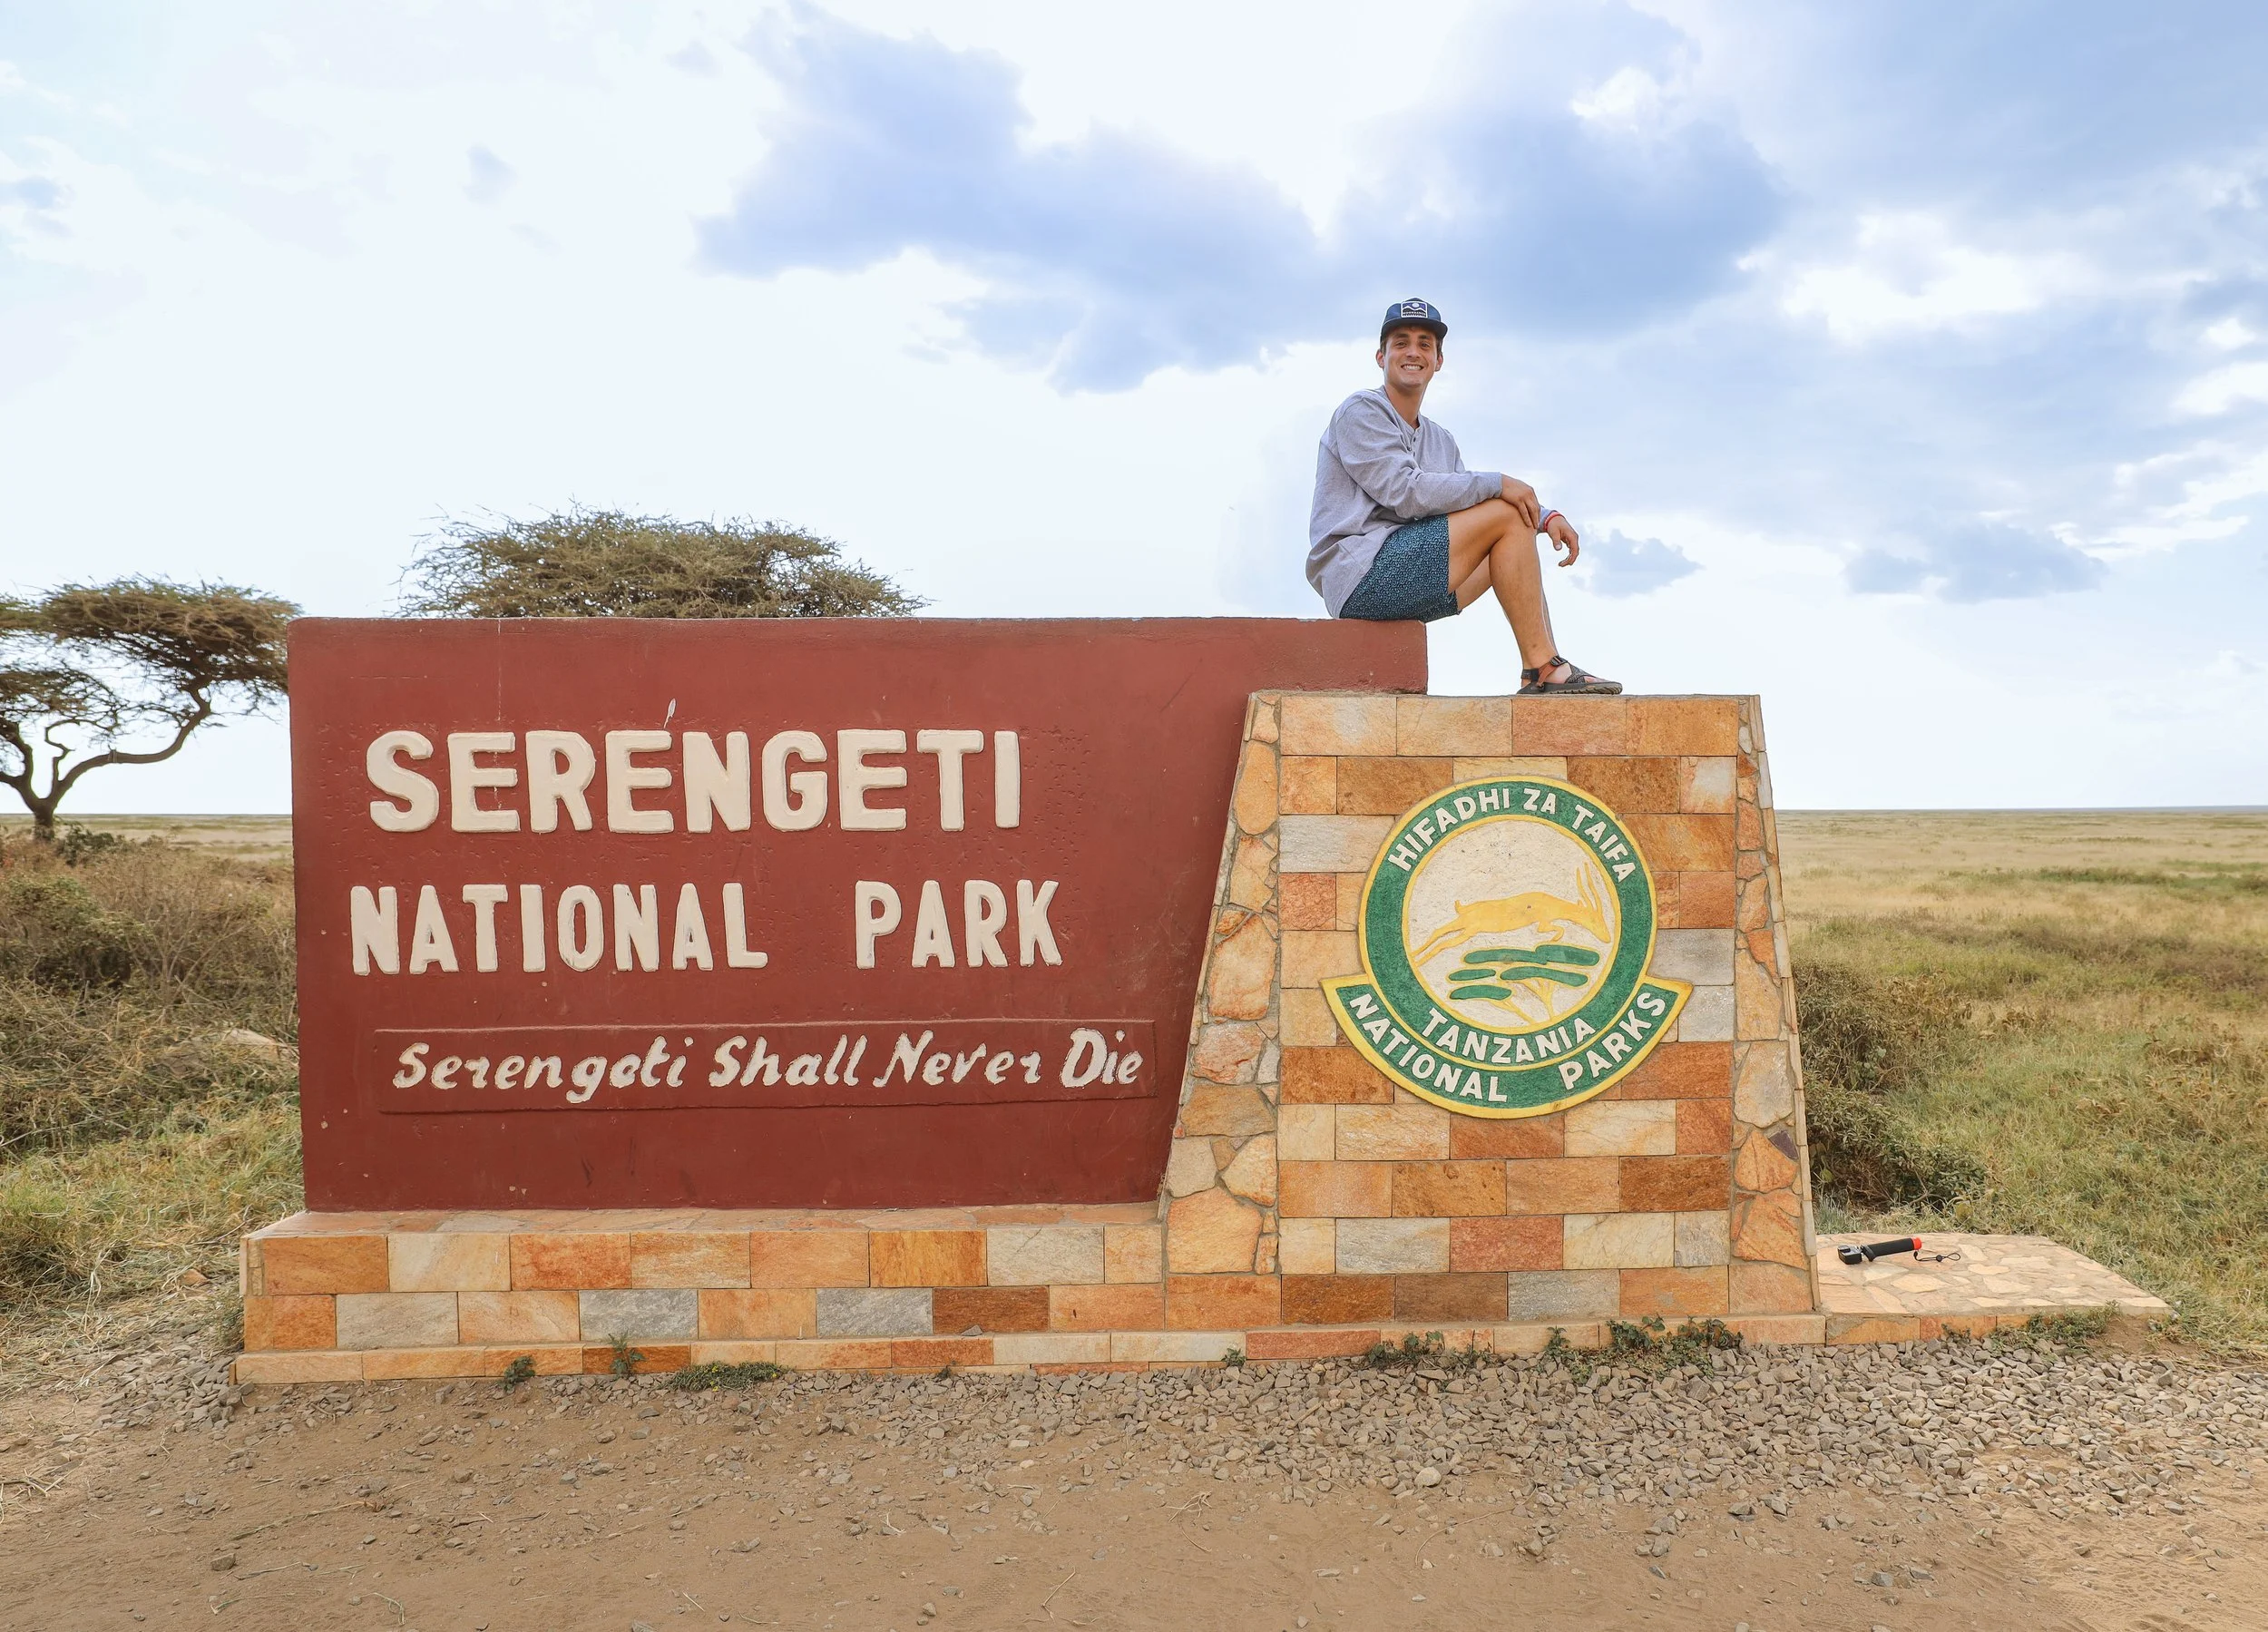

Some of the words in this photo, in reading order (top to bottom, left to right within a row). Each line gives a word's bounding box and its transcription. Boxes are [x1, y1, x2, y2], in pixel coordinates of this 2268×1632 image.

[366, 729, 1021, 833] SERENGETI
[1387, 787, 1510, 872] HIFADHI
[1522, 787, 1557, 815] ZA
[1571, 804, 1636, 883] TAIFA
[350, 882, 768, 976] NATIONAL
[855, 878, 1063, 970] PARK
[392, 1035, 694, 1104] Serengeti
[708, 1034, 863, 1088] Shall
[872, 1030, 1041, 1088] Never
[1059, 1027, 1144, 1089] Die
[1349, 993, 1508, 1103] NATIONAL
[1558, 992, 1666, 1090] PARKS
[1422, 1006, 1597, 1064] TANZANIA
